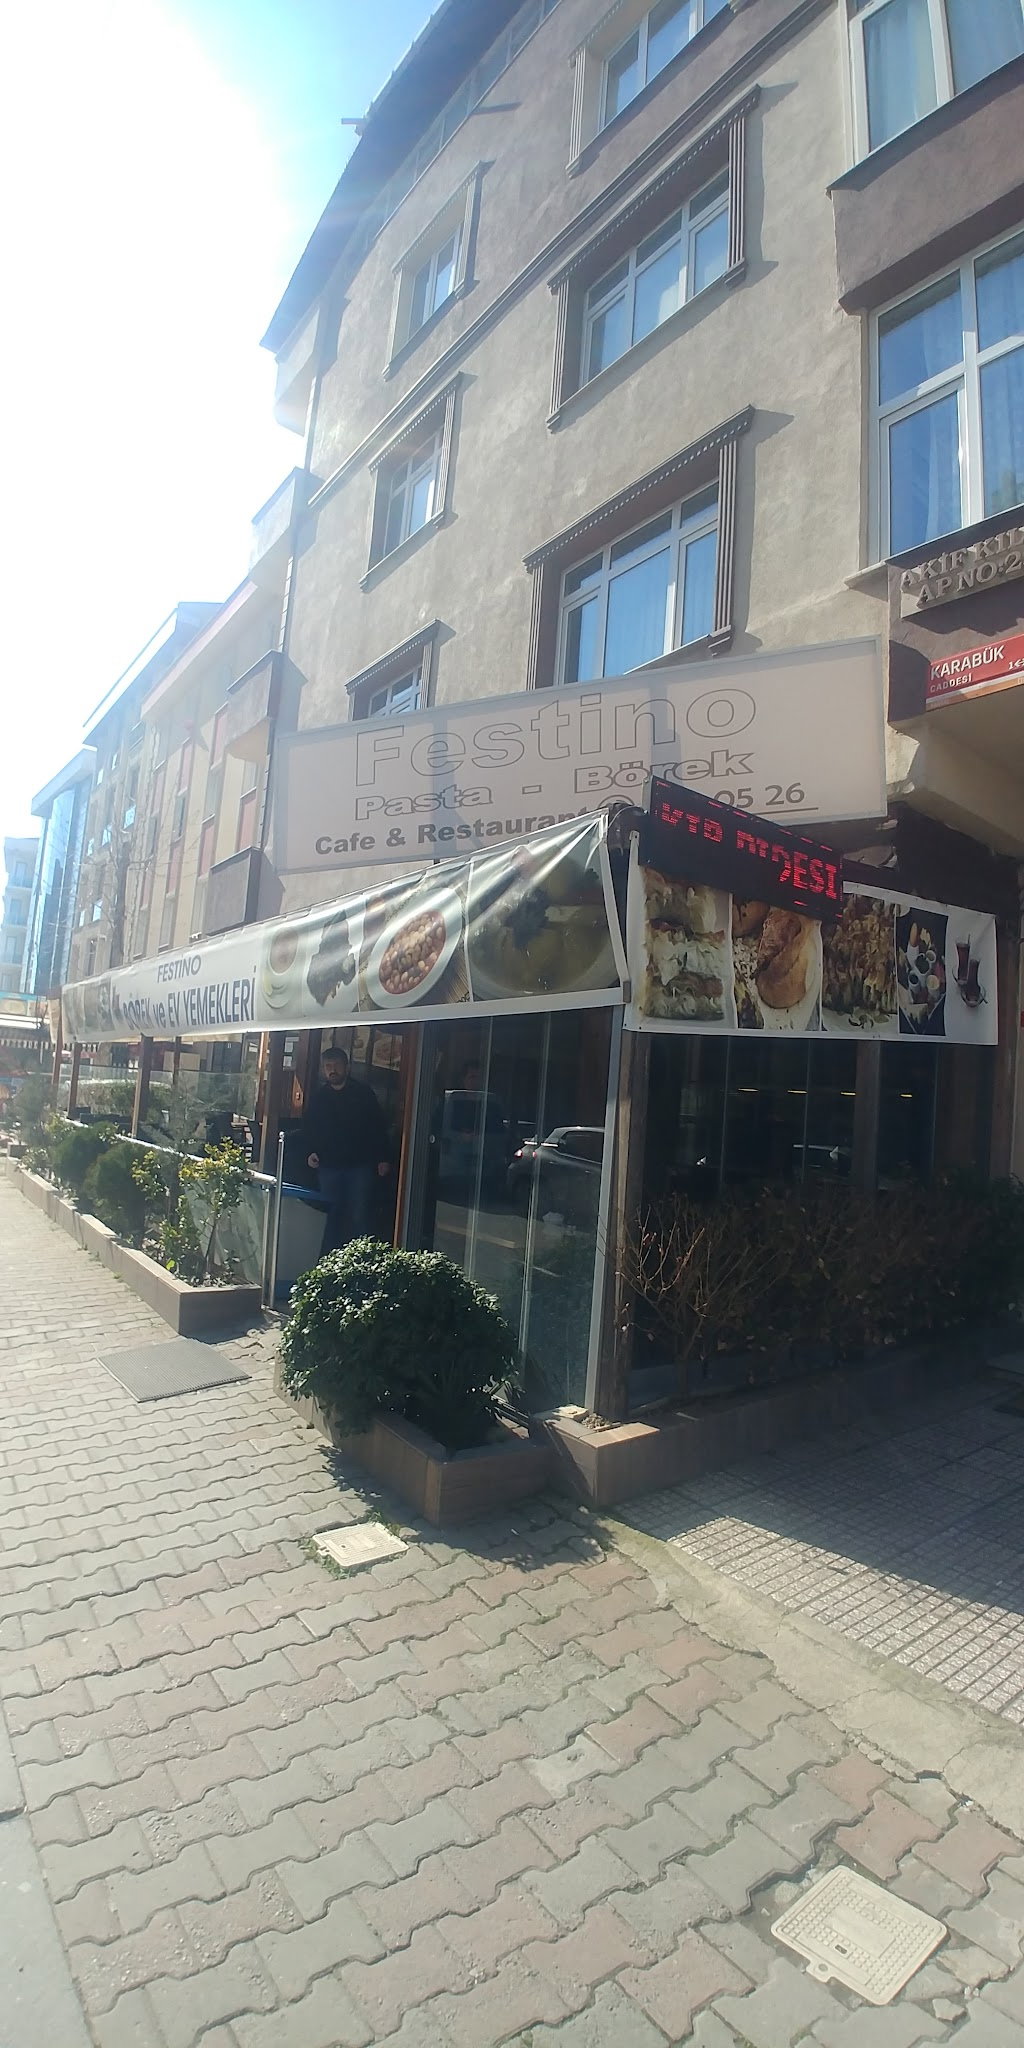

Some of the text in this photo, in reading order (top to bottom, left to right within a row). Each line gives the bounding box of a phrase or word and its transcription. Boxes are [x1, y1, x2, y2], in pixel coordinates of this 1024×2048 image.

[930, 645, 1005, 681] KARABÜK
[354, 687, 757, 787] Festino
[315, 832, 376, 855] Cafe
[386, 827, 406, 847] &
[765, 782, 805, 806] 26
[354, 784, 493, 821] Pasta
[574, 750, 754, 793] Börek
[153, 1001, 167, 1029] ve
[167, 991, 181, 1028] EV
[183, 965, 257, 1027] YEMEKLERİ
